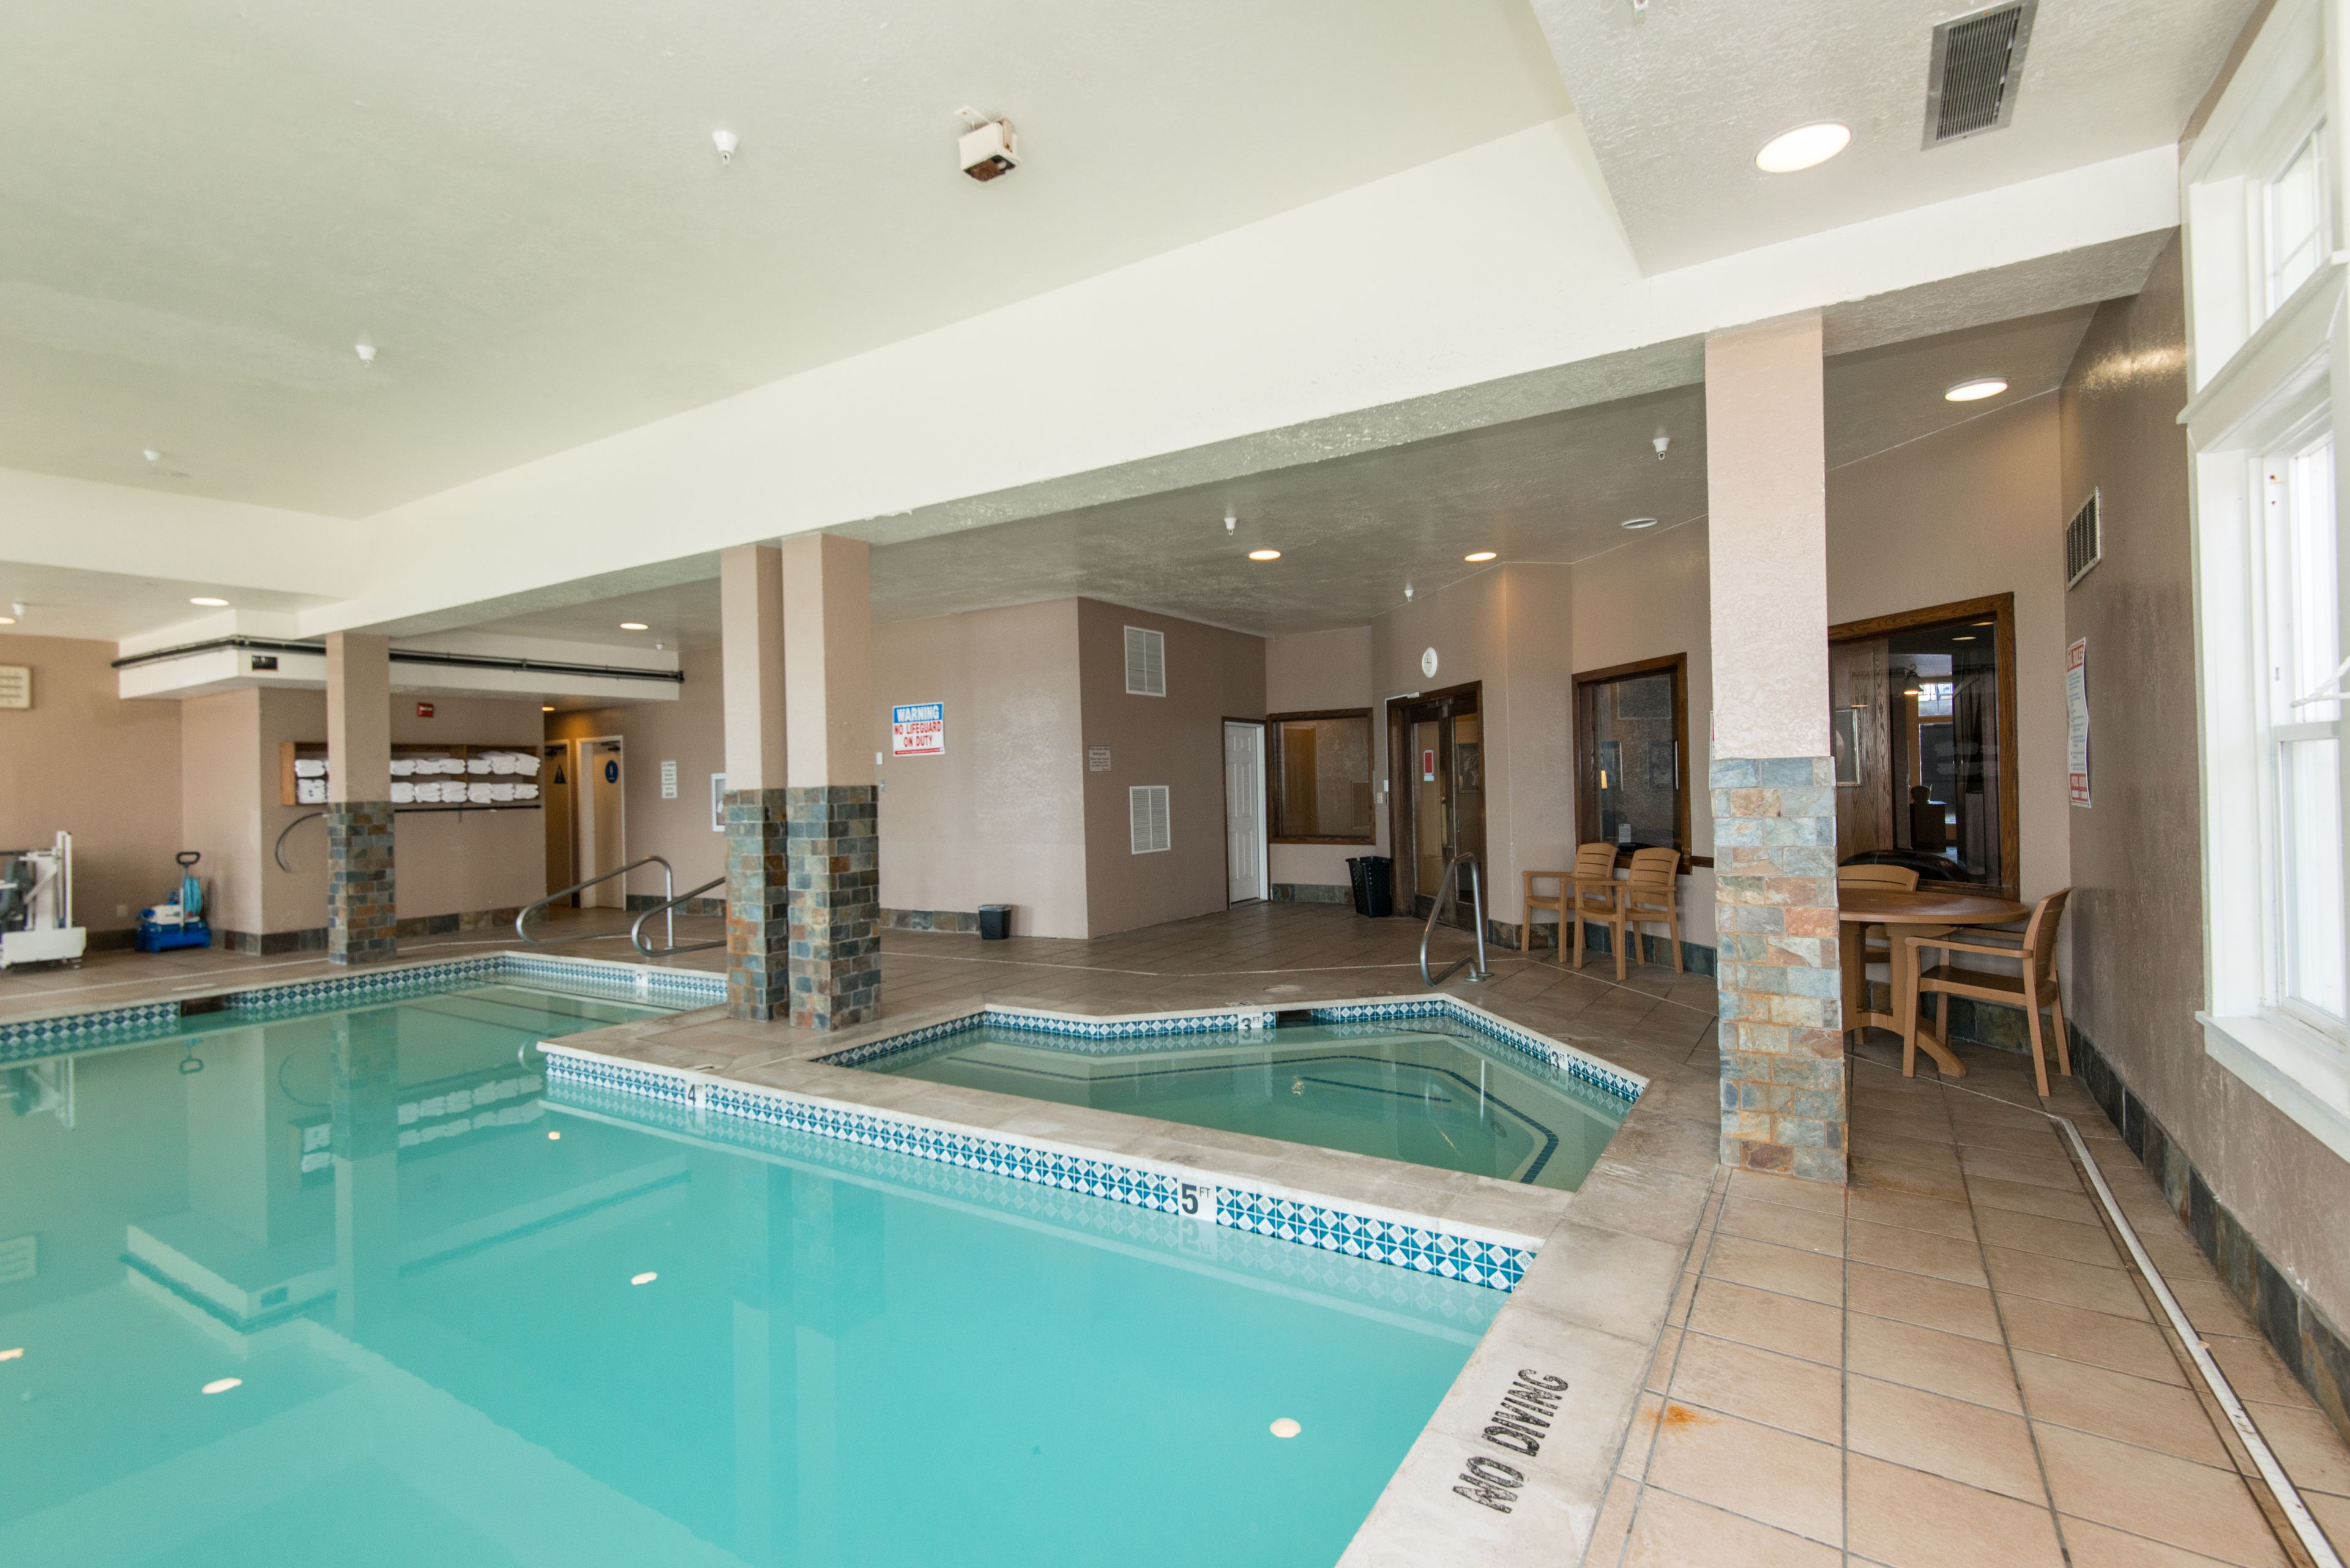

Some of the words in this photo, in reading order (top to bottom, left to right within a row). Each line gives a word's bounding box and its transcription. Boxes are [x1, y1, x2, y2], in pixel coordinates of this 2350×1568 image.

[897, 705, 939, 722] WARNING
[894, 724, 903, 735] NO
[906, 721, 941, 734] LIFEGUARD
[904, 736, 912, 747] ON
[916, 734, 932, 746] DUTY
[1242, 1018, 1251, 1029] 3
[1552, 1051, 1559, 1068] 3
[688, 1084, 696, 1106] 4
[1182, 1183, 1198, 1214] 5
[1199, 1187, 1210, 1198] FT
[1482, 1368, 1569, 1457] DIVING
[1452, 1456, 1524, 1514] NO
